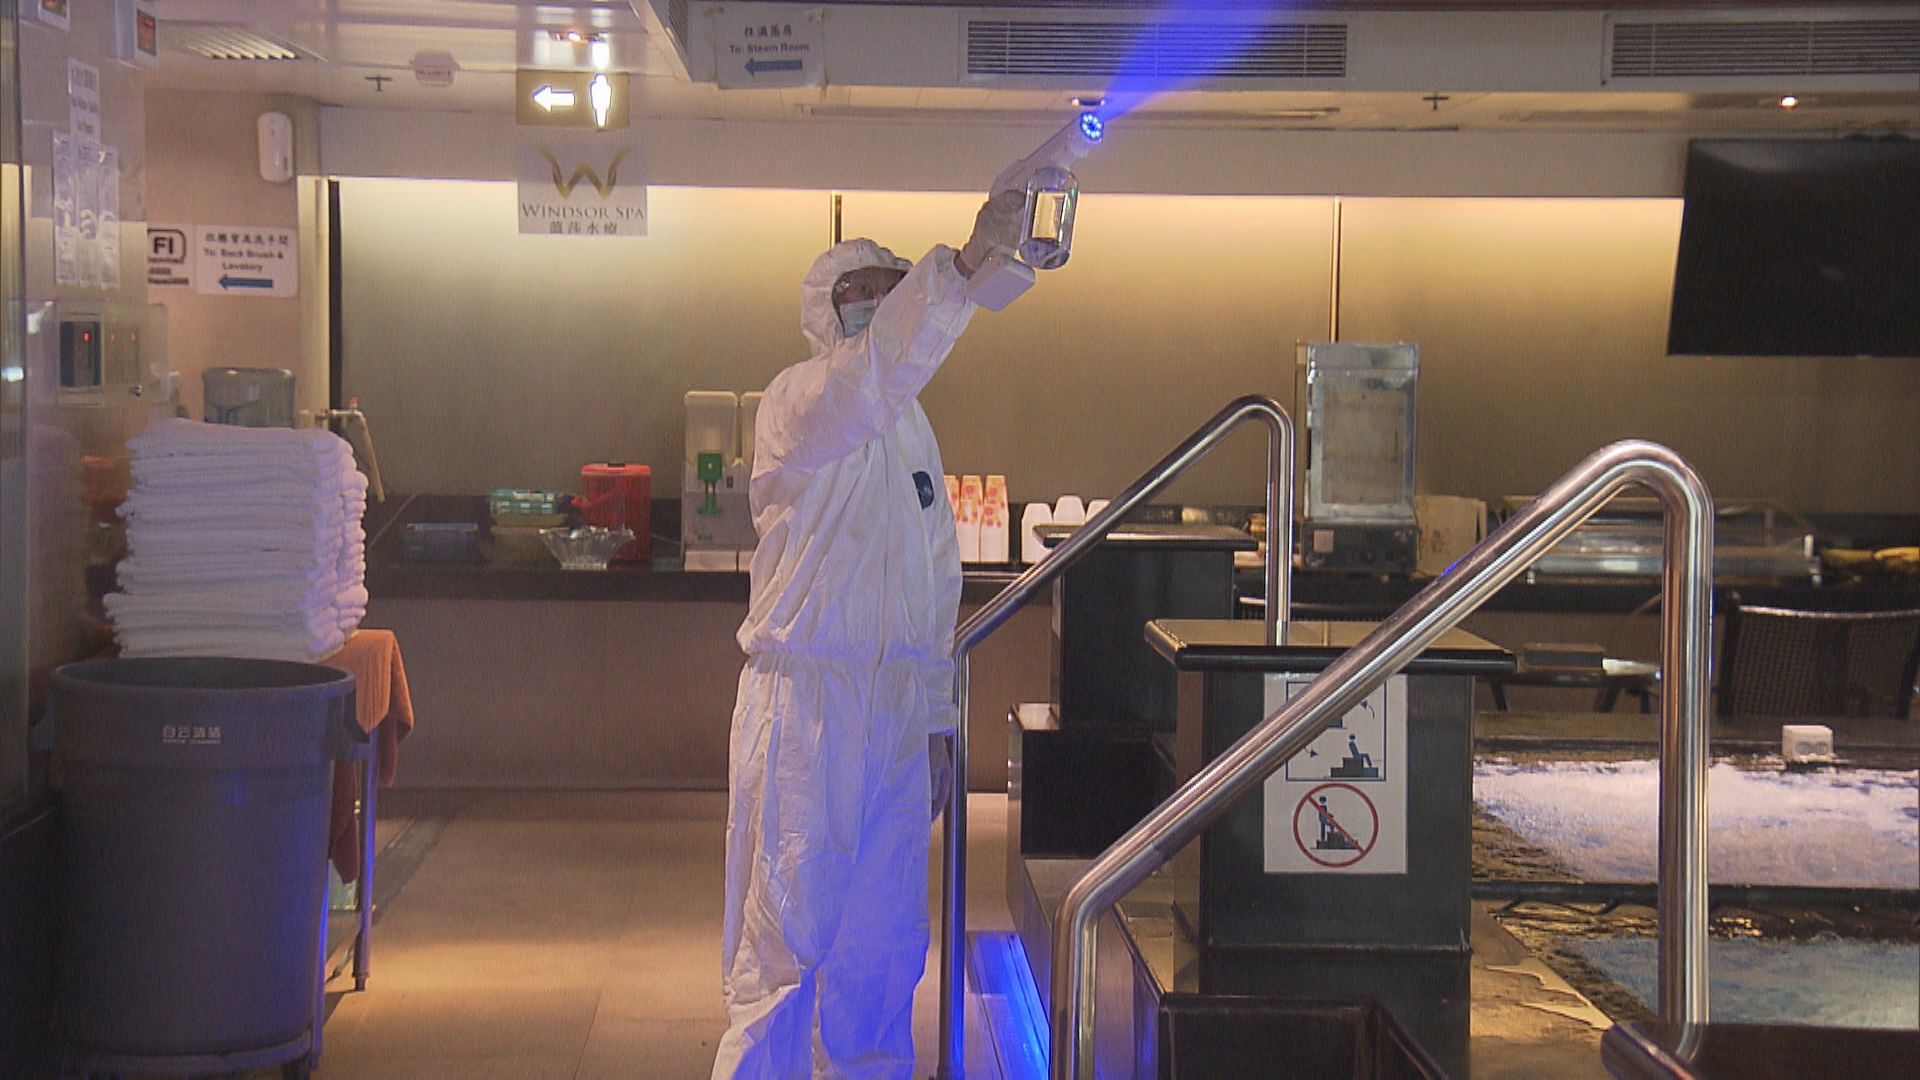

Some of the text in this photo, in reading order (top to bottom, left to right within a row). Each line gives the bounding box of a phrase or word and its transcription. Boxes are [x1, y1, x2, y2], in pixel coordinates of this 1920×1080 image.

[747, 43, 778, 53] Steam
[780, 42, 809, 52] Room
[220, 249, 243, 258] Back
[246, 249, 275, 259] Brush
[222, 262, 263, 273] Lavatory
